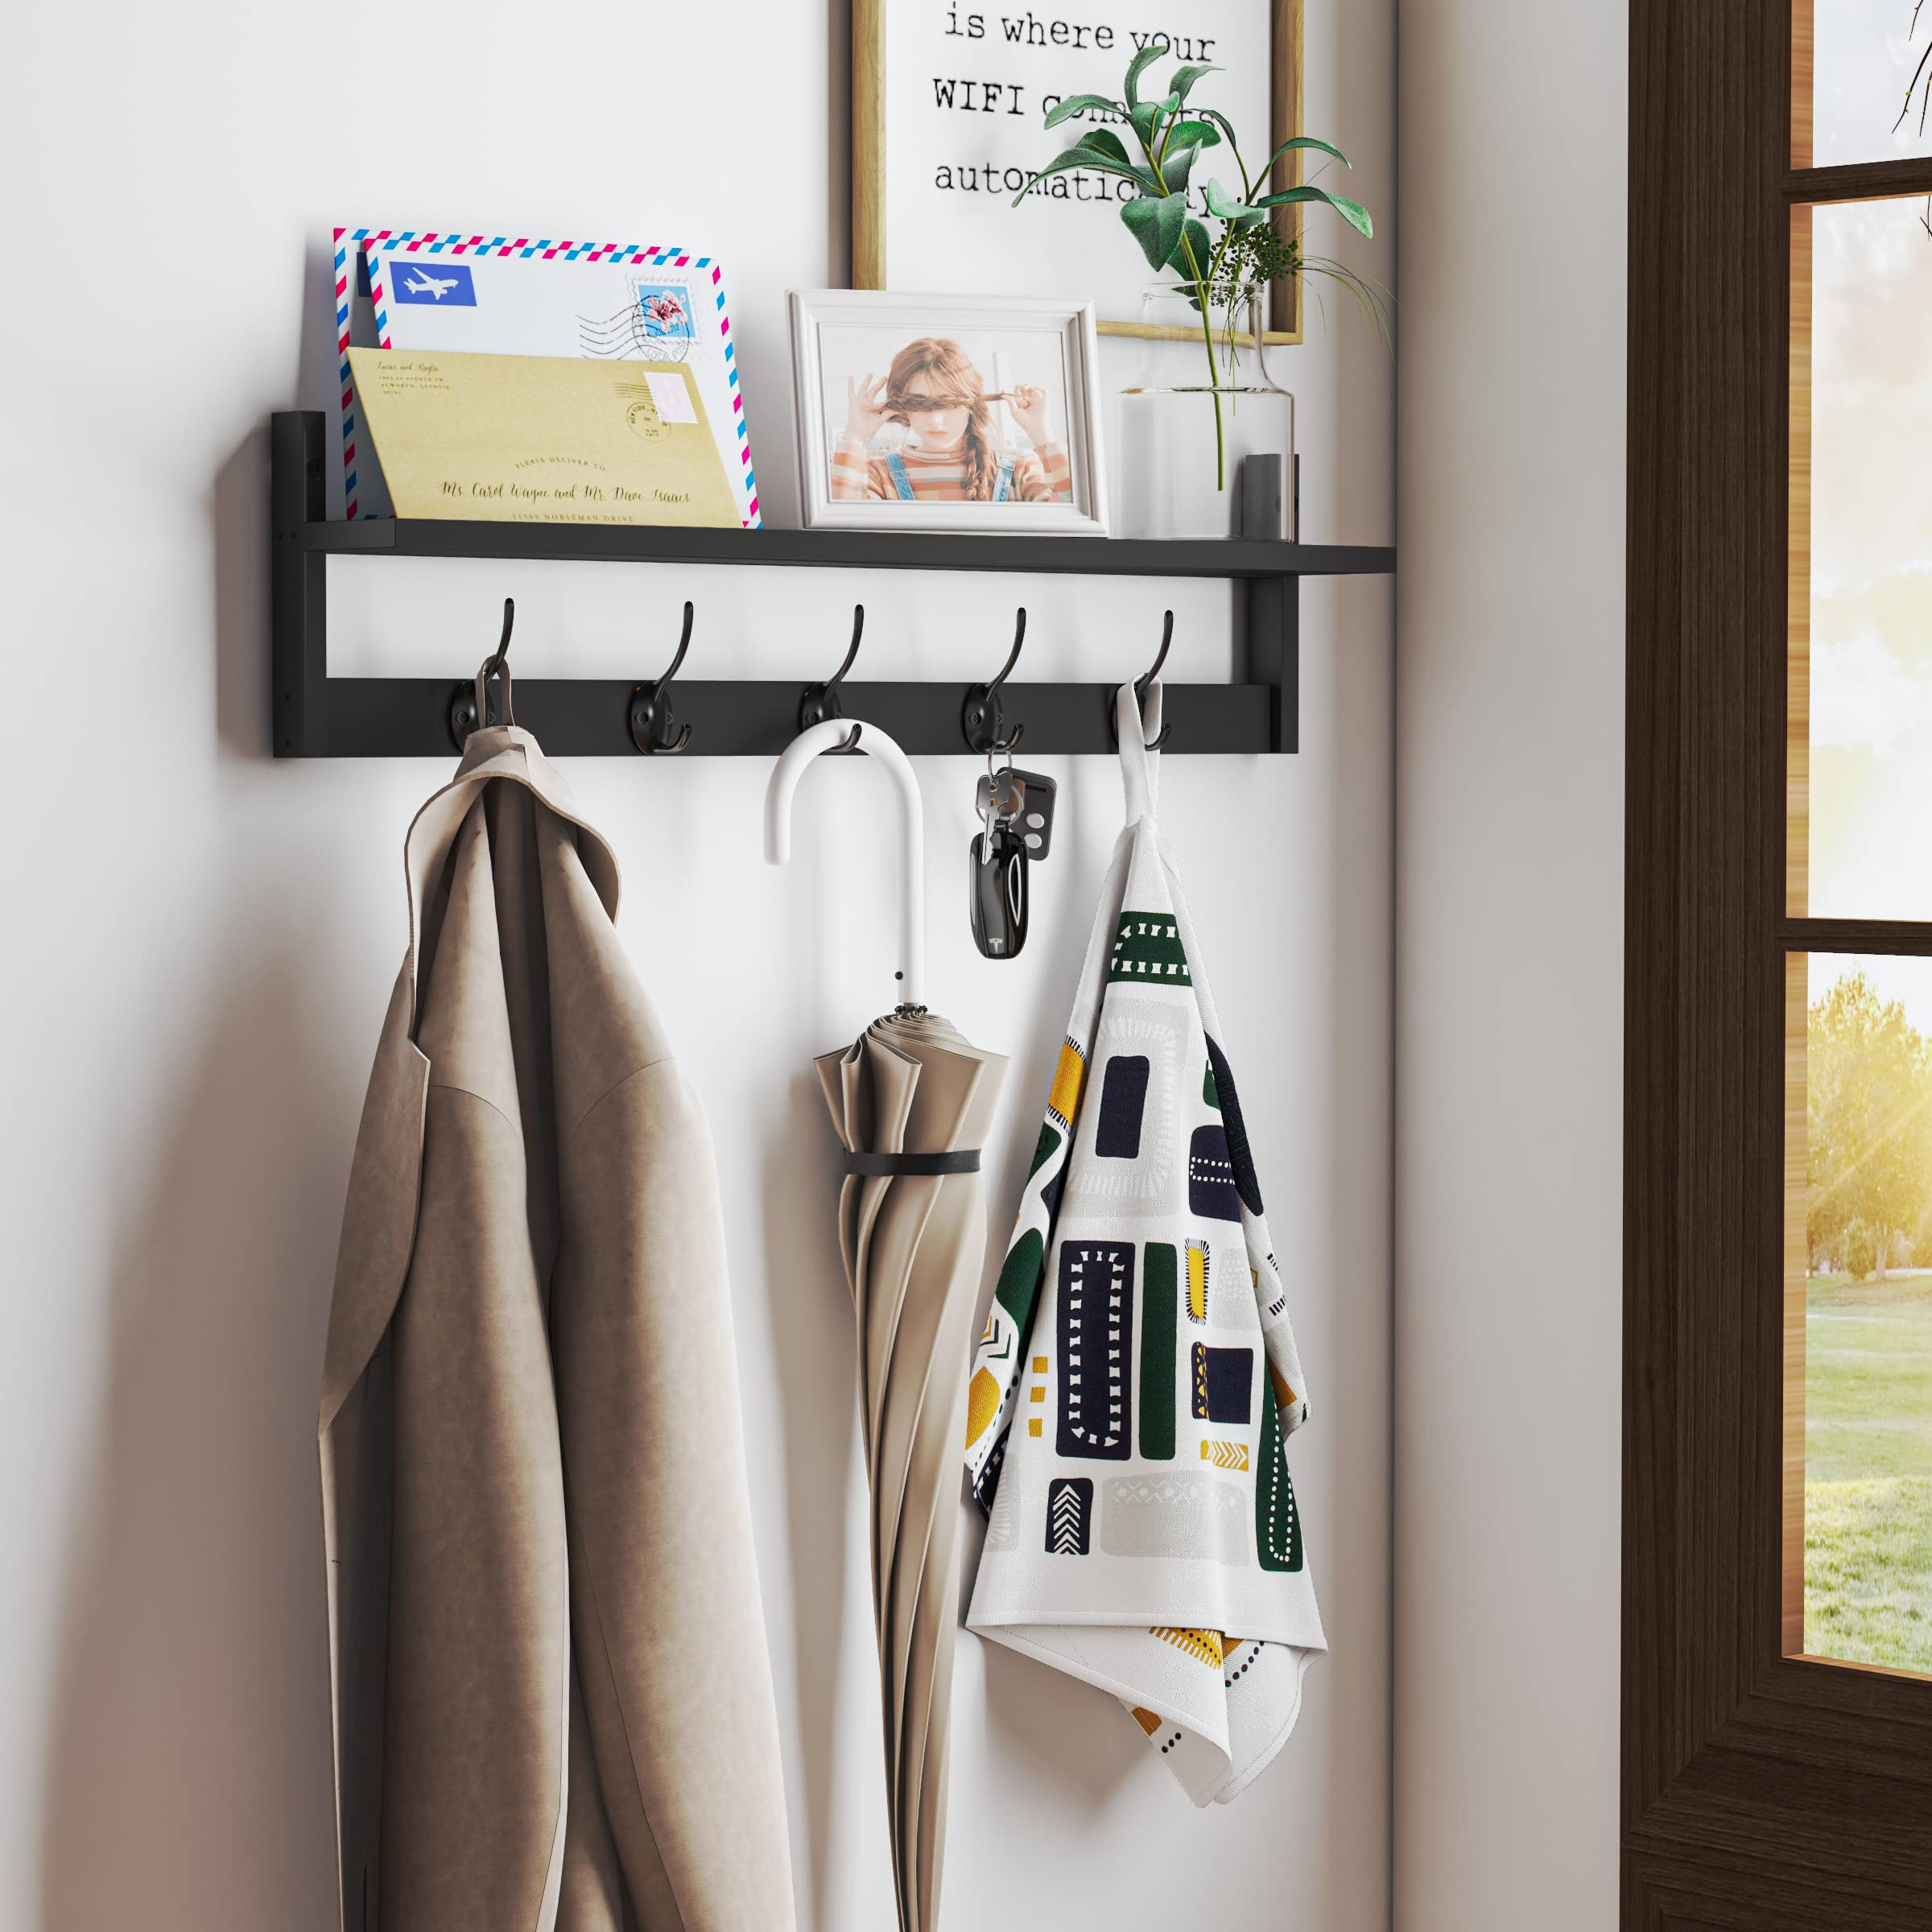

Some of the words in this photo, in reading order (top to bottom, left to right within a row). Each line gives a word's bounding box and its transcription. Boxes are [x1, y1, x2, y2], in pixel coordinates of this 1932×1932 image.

[945, 0, 985, 39] is
[1001, 12, 1115, 50] where
[1129, 32, 1216, 64] your
[933, 78, 1025, 115] WIFI
[514, 456, 546, 470] PLEASE
[549, 456, 589, 467] DELIVER
[472, 481, 504, 498] Carol
[510, 482, 547, 505] Wayne
[553, 485, 577, 499] and
[612, 486, 644, 502] Dave
